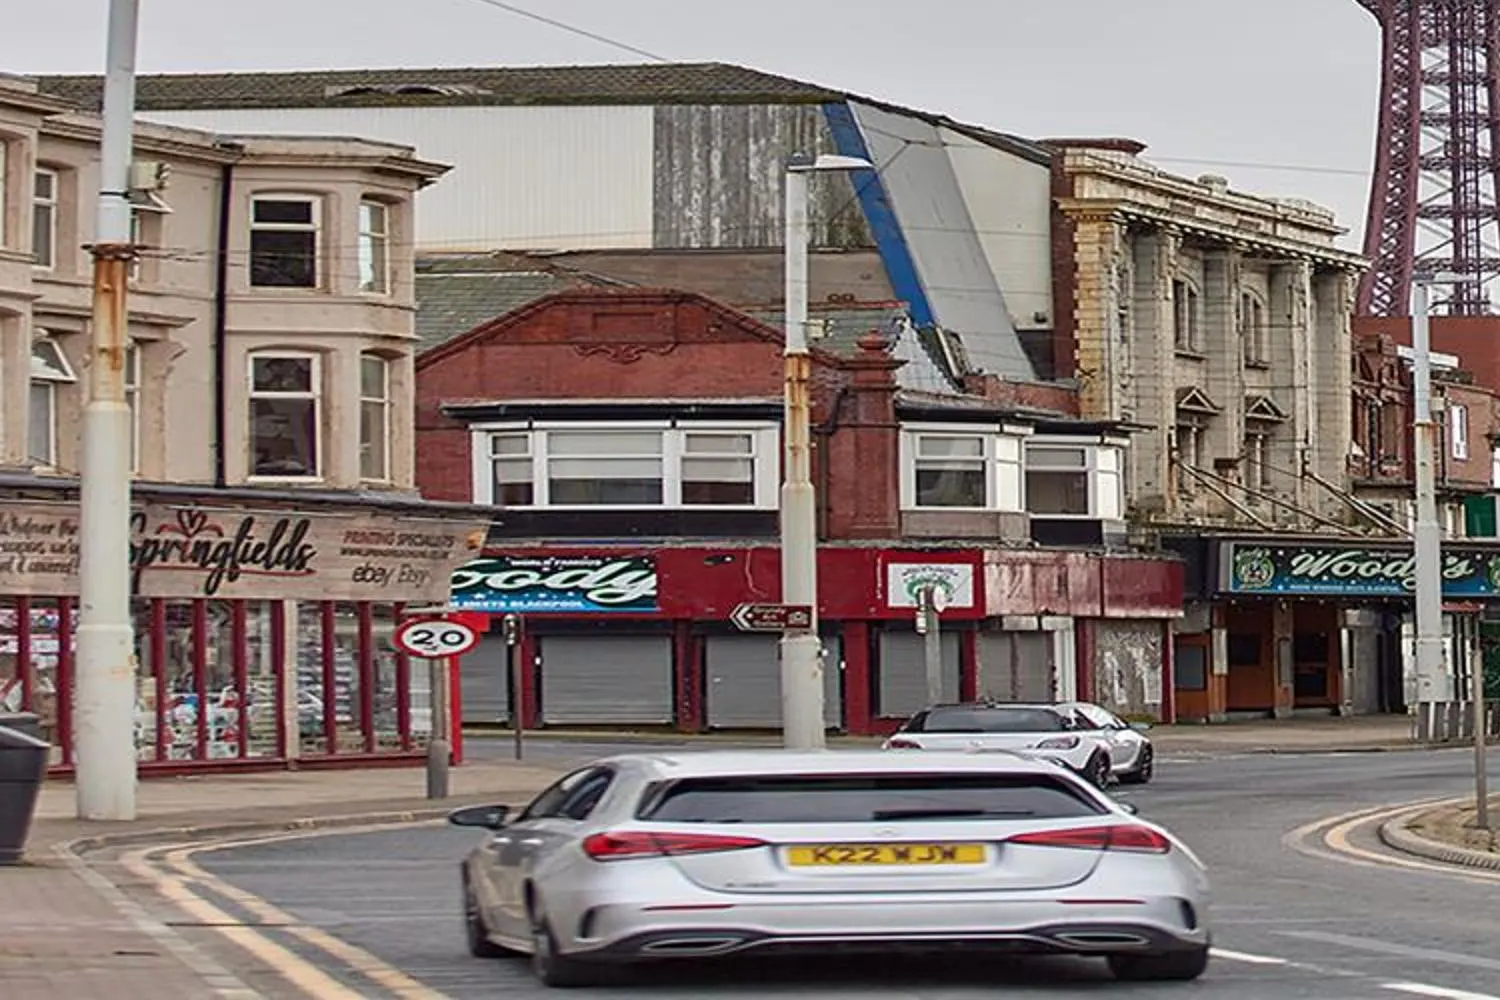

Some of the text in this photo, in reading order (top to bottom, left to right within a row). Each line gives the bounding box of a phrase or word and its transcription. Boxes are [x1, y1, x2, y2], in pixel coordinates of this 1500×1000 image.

[352, 561, 395, 588] ebay
[451, 559, 657, 604] oody
[1290, 550, 1476, 590] Wood's
[411, 629, 466, 647] 20
[813, 846, 881, 863] K22
